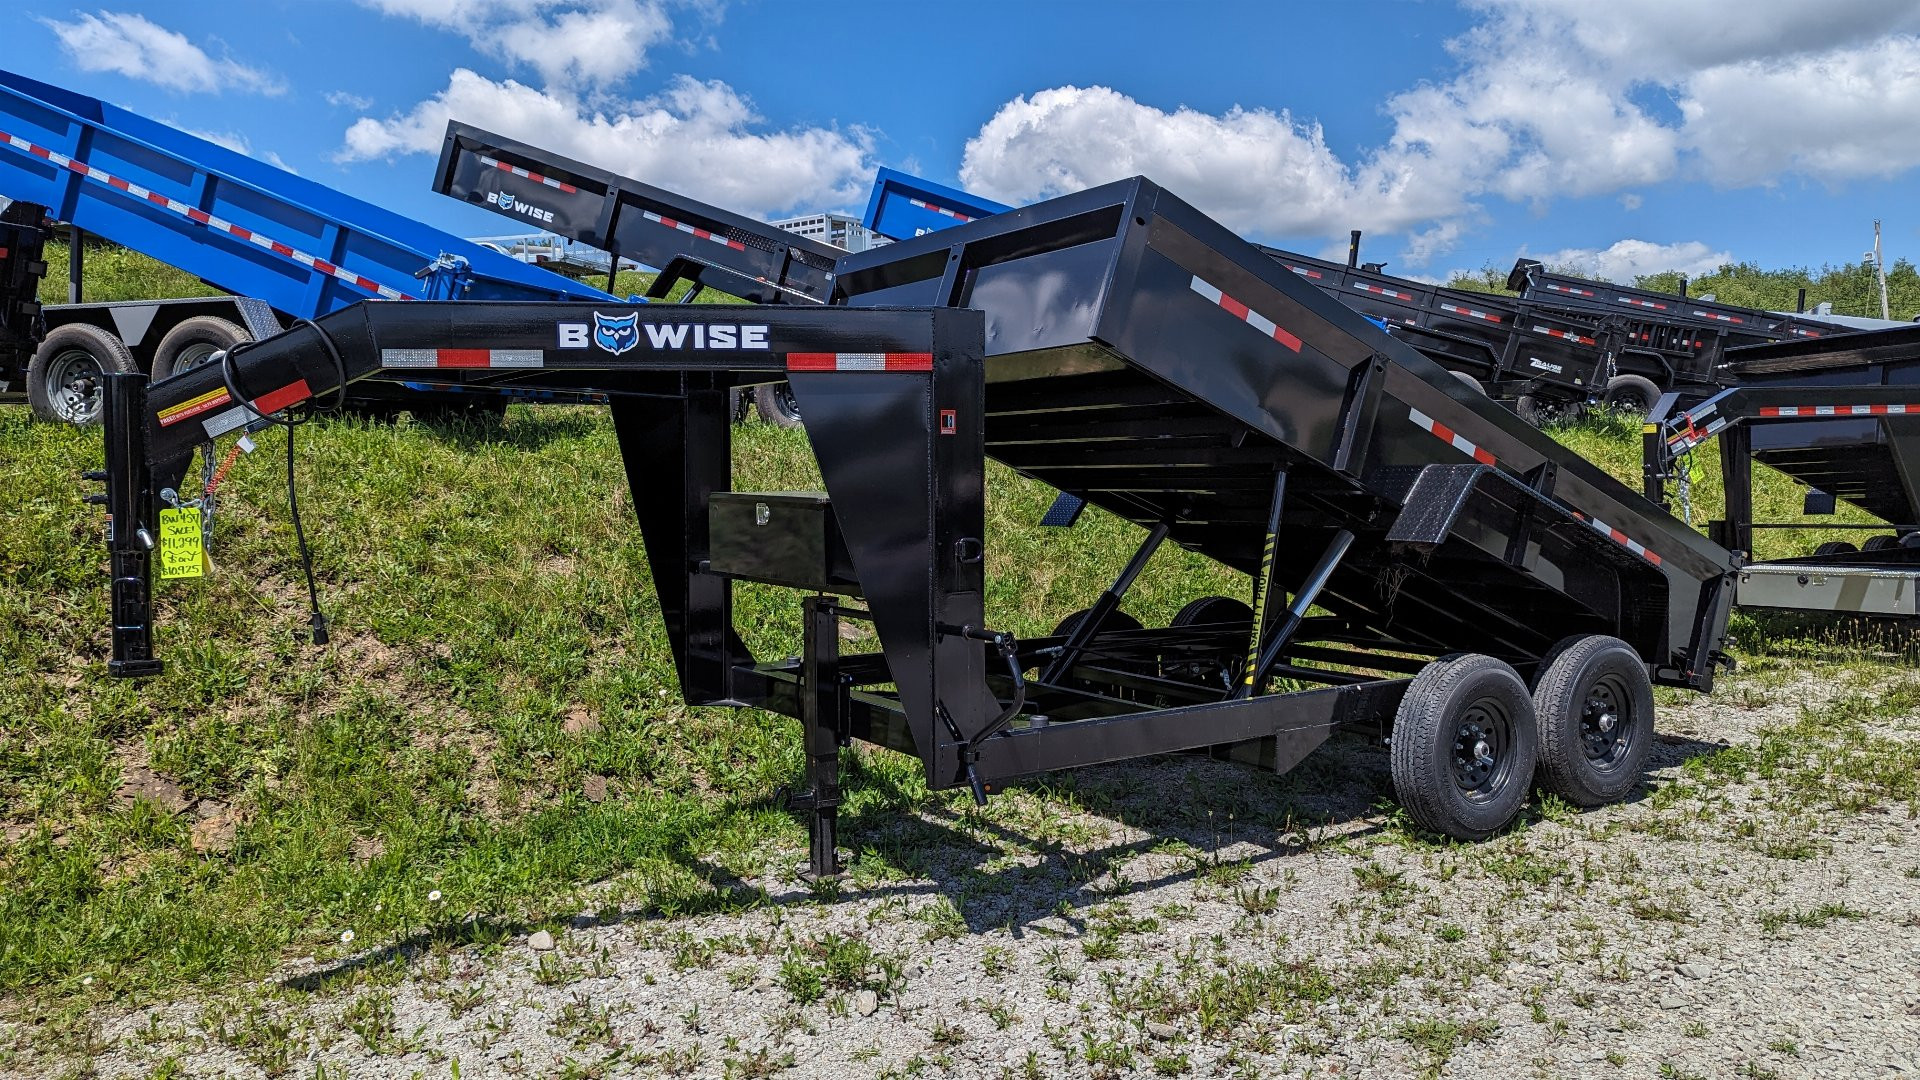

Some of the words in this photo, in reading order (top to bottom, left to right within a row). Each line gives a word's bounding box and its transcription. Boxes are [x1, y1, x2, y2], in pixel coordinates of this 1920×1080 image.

[515, 201, 554, 223] WISE
[644, 324, 769, 349] WISE
[167, 526, 195, 536] SALE!
[1250, 605, 1262, 646] SAFETY
[1257, 570, 1268, 600] PROP
